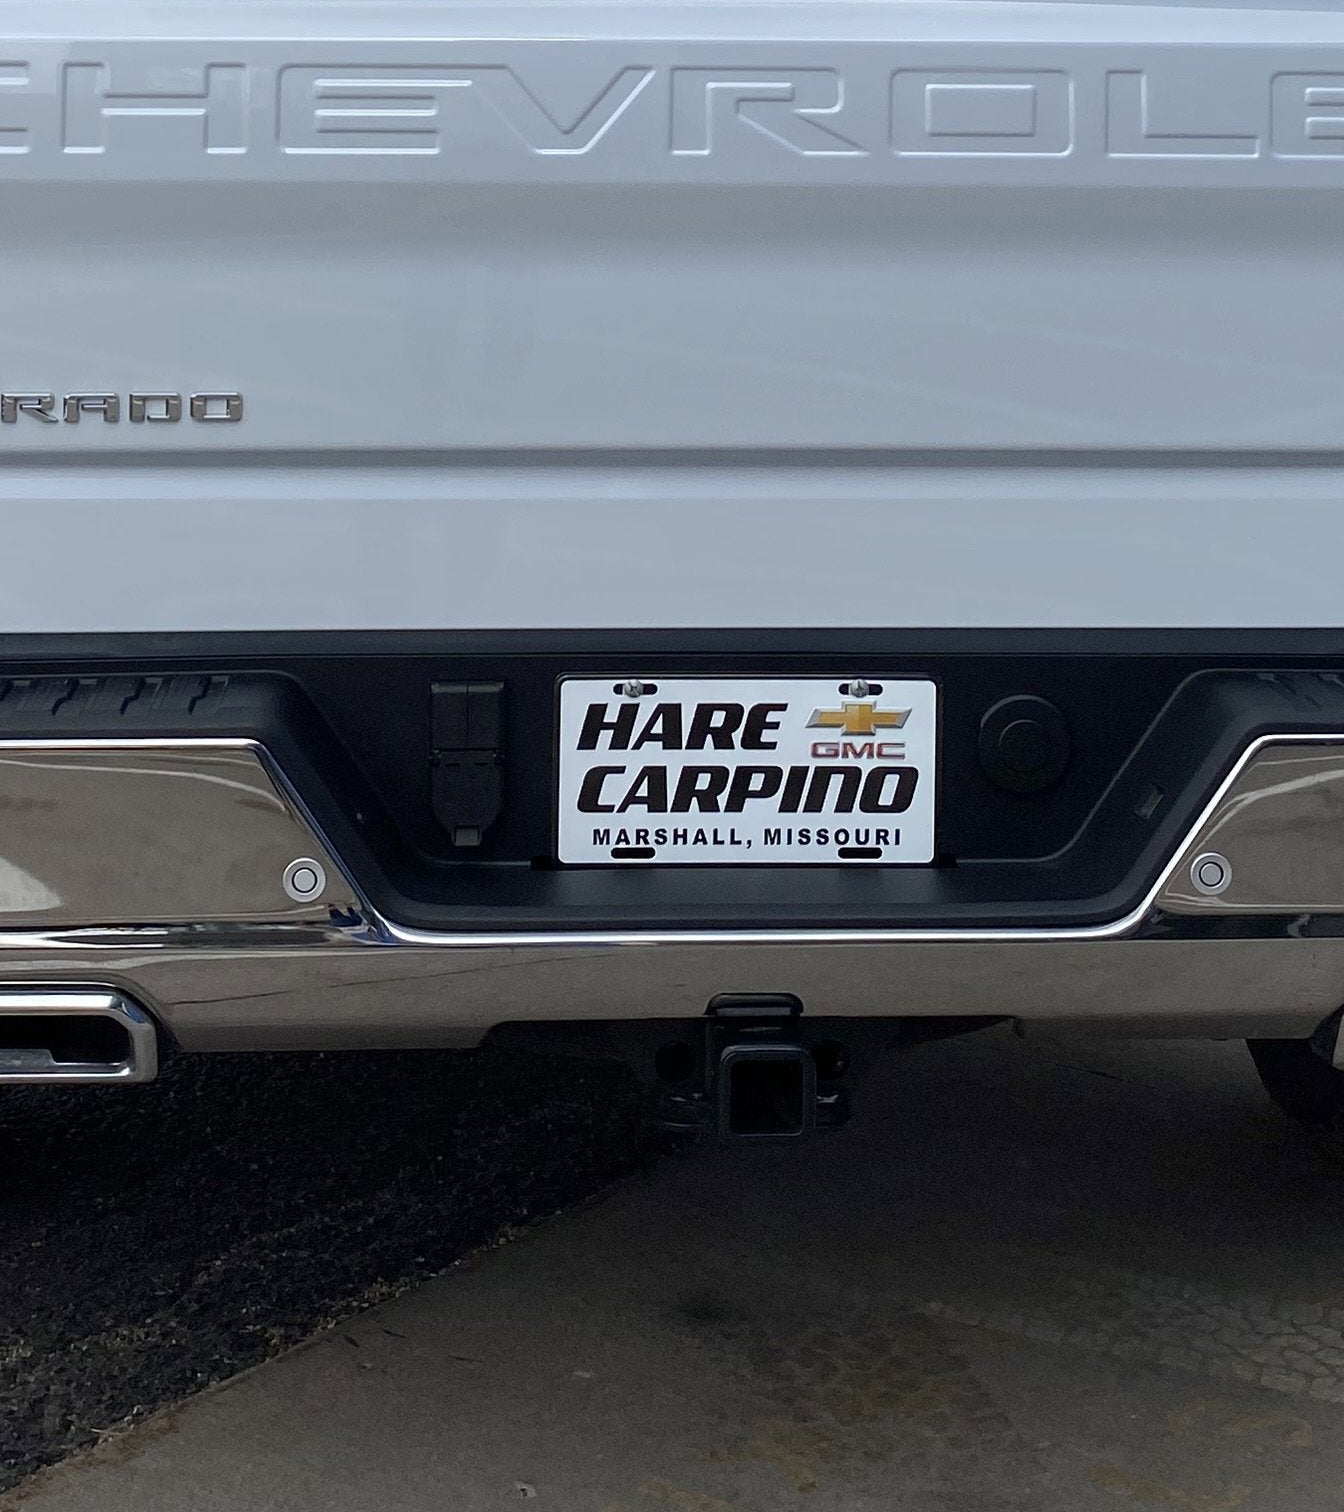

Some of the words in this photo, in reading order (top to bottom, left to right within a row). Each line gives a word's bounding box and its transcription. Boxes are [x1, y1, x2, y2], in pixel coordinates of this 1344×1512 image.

[576, 702, 789, 751] HARE
[809, 741, 906, 760] GMC
[576, 764, 920, 814] CARPINO
[592, 827, 753, 849] MARSHALL,
[763, 827, 902, 846] MISSOURI
